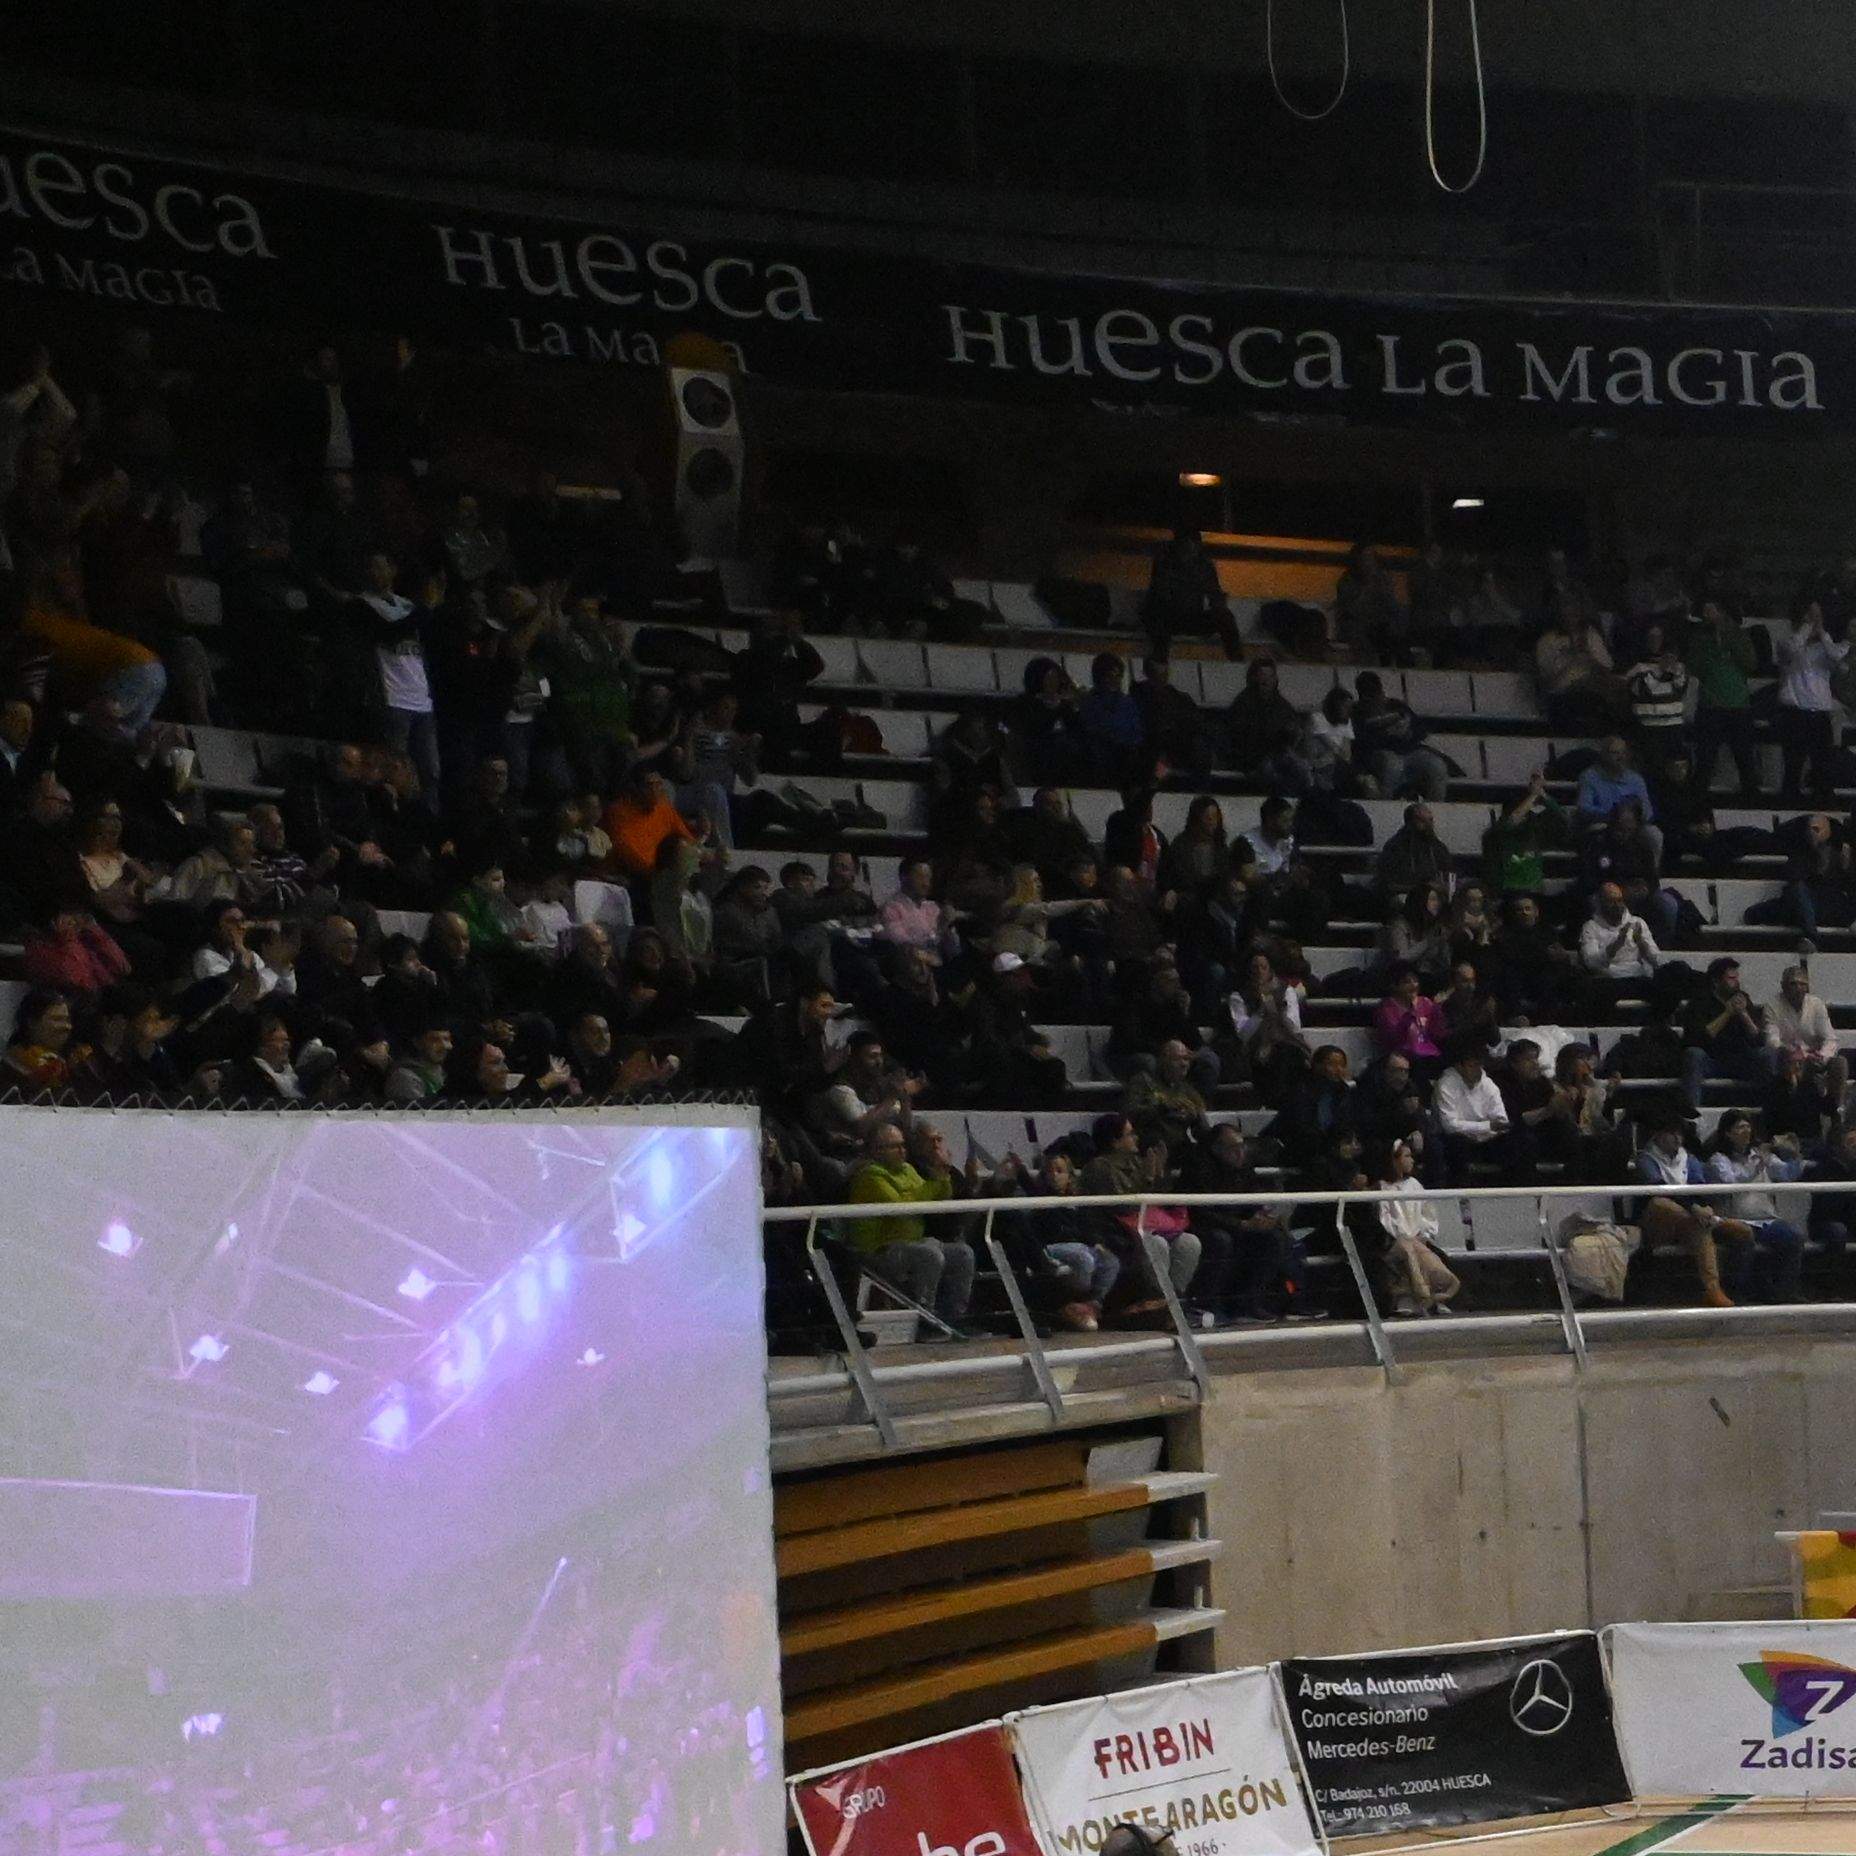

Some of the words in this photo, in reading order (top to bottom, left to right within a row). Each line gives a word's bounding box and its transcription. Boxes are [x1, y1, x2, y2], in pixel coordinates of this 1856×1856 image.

[509, 317, 574, 360] La
[1375, 333, 1491, 399] La
[1366, 1672, 1458, 1696] Automóvil
[1302, 1706, 1429, 1729] Concesionario
[1094, 1717, 1215, 1780] FRIBIN
[1307, 1735, 1436, 1760] Mercedes-Benz
[1402, 1778, 1441, 1795] 22004
[1442, 1773, 1492, 1791] HUESCA
[1343, 1806, 1365, 1820] 974
[1366, 1804, 1388, 1818] 210
